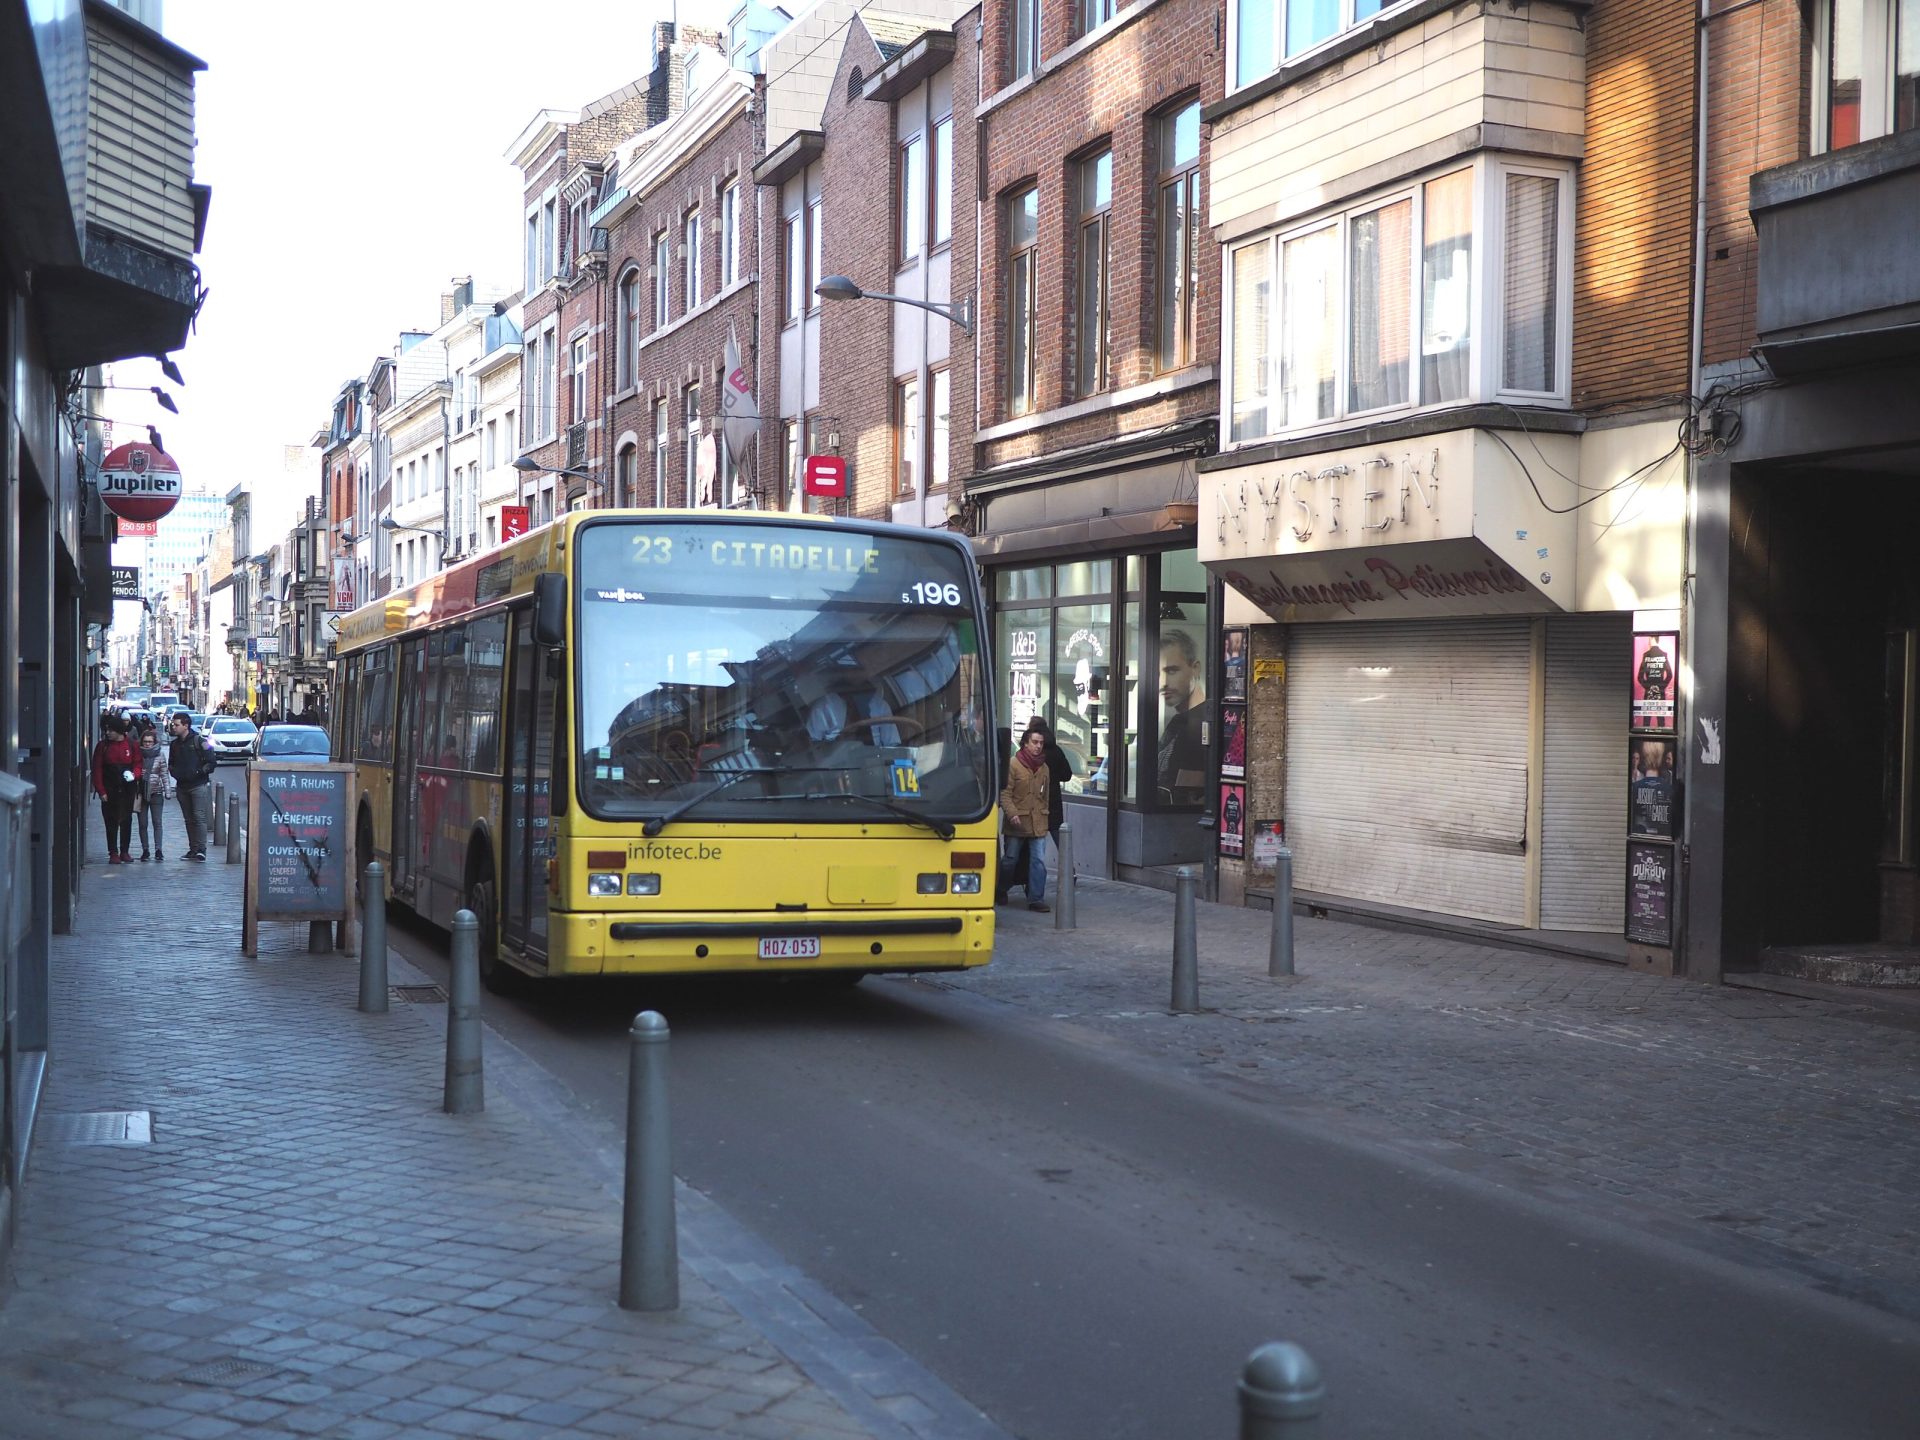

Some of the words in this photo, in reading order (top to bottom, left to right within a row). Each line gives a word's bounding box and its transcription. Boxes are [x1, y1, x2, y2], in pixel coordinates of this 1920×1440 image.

[103, 475, 177, 494] Jupiler
[1217, 449, 1439, 545] NYSTEN
[121, 523, 135, 531] 250
[136, 523, 146, 531] 59
[632, 535, 673, 565] 23
[711, 540, 880, 574] CITADELLE
[336, 591, 353, 603] VGM
[1011, 630, 1037, 657] I&B
[268, 776, 288, 788] BAR
[290, 774, 298, 788] À
[301, 777, 335, 789] RHUMS
[896, 767, 918, 793] 14
[628, 842, 722, 860] infotec.be
